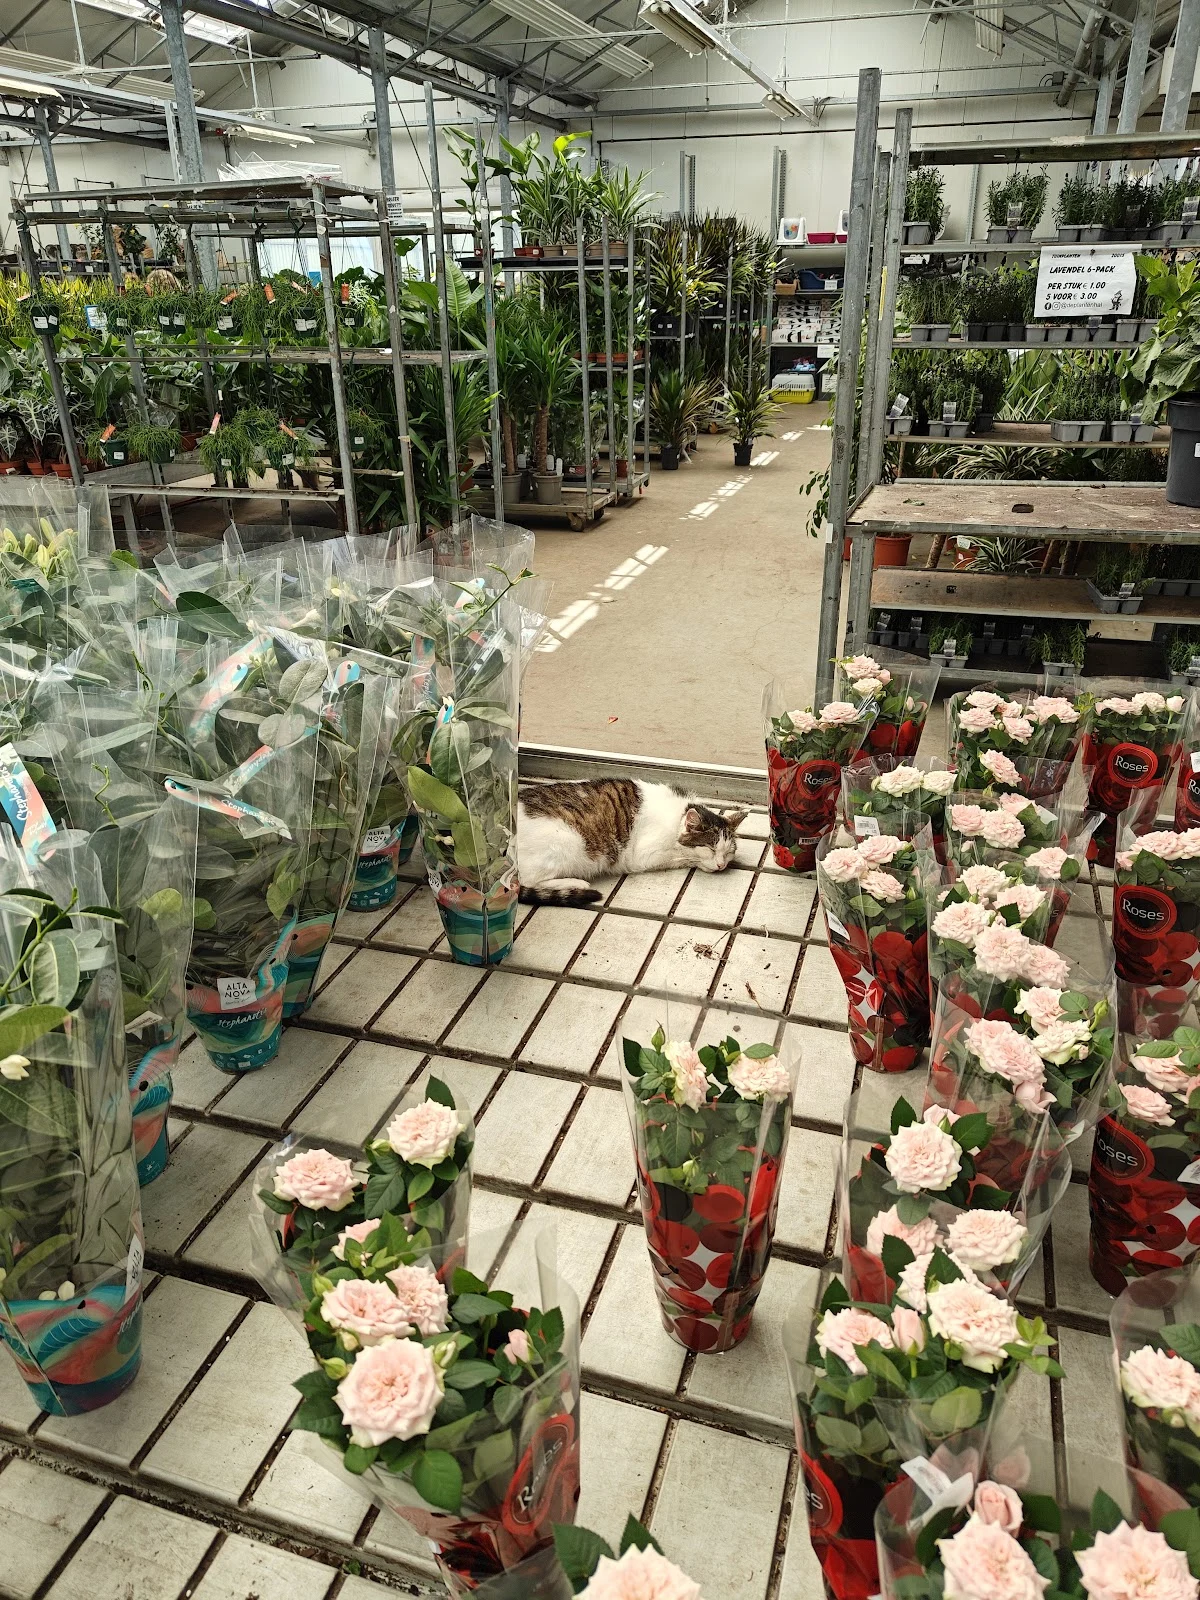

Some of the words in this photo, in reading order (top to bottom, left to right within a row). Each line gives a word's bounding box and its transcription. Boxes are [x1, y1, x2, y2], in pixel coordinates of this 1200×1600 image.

[1086, 265, 1116, 273] 6-PACK
[1114, 755, 1150, 773] Roses
[803, 772, 834, 786] Roses
[1122, 897, 1165, 921] Roses
[224, 989, 251, 998] NOVA
[226, 982, 248, 991] ALTA
[1096, 1137, 1139, 1168] oses
